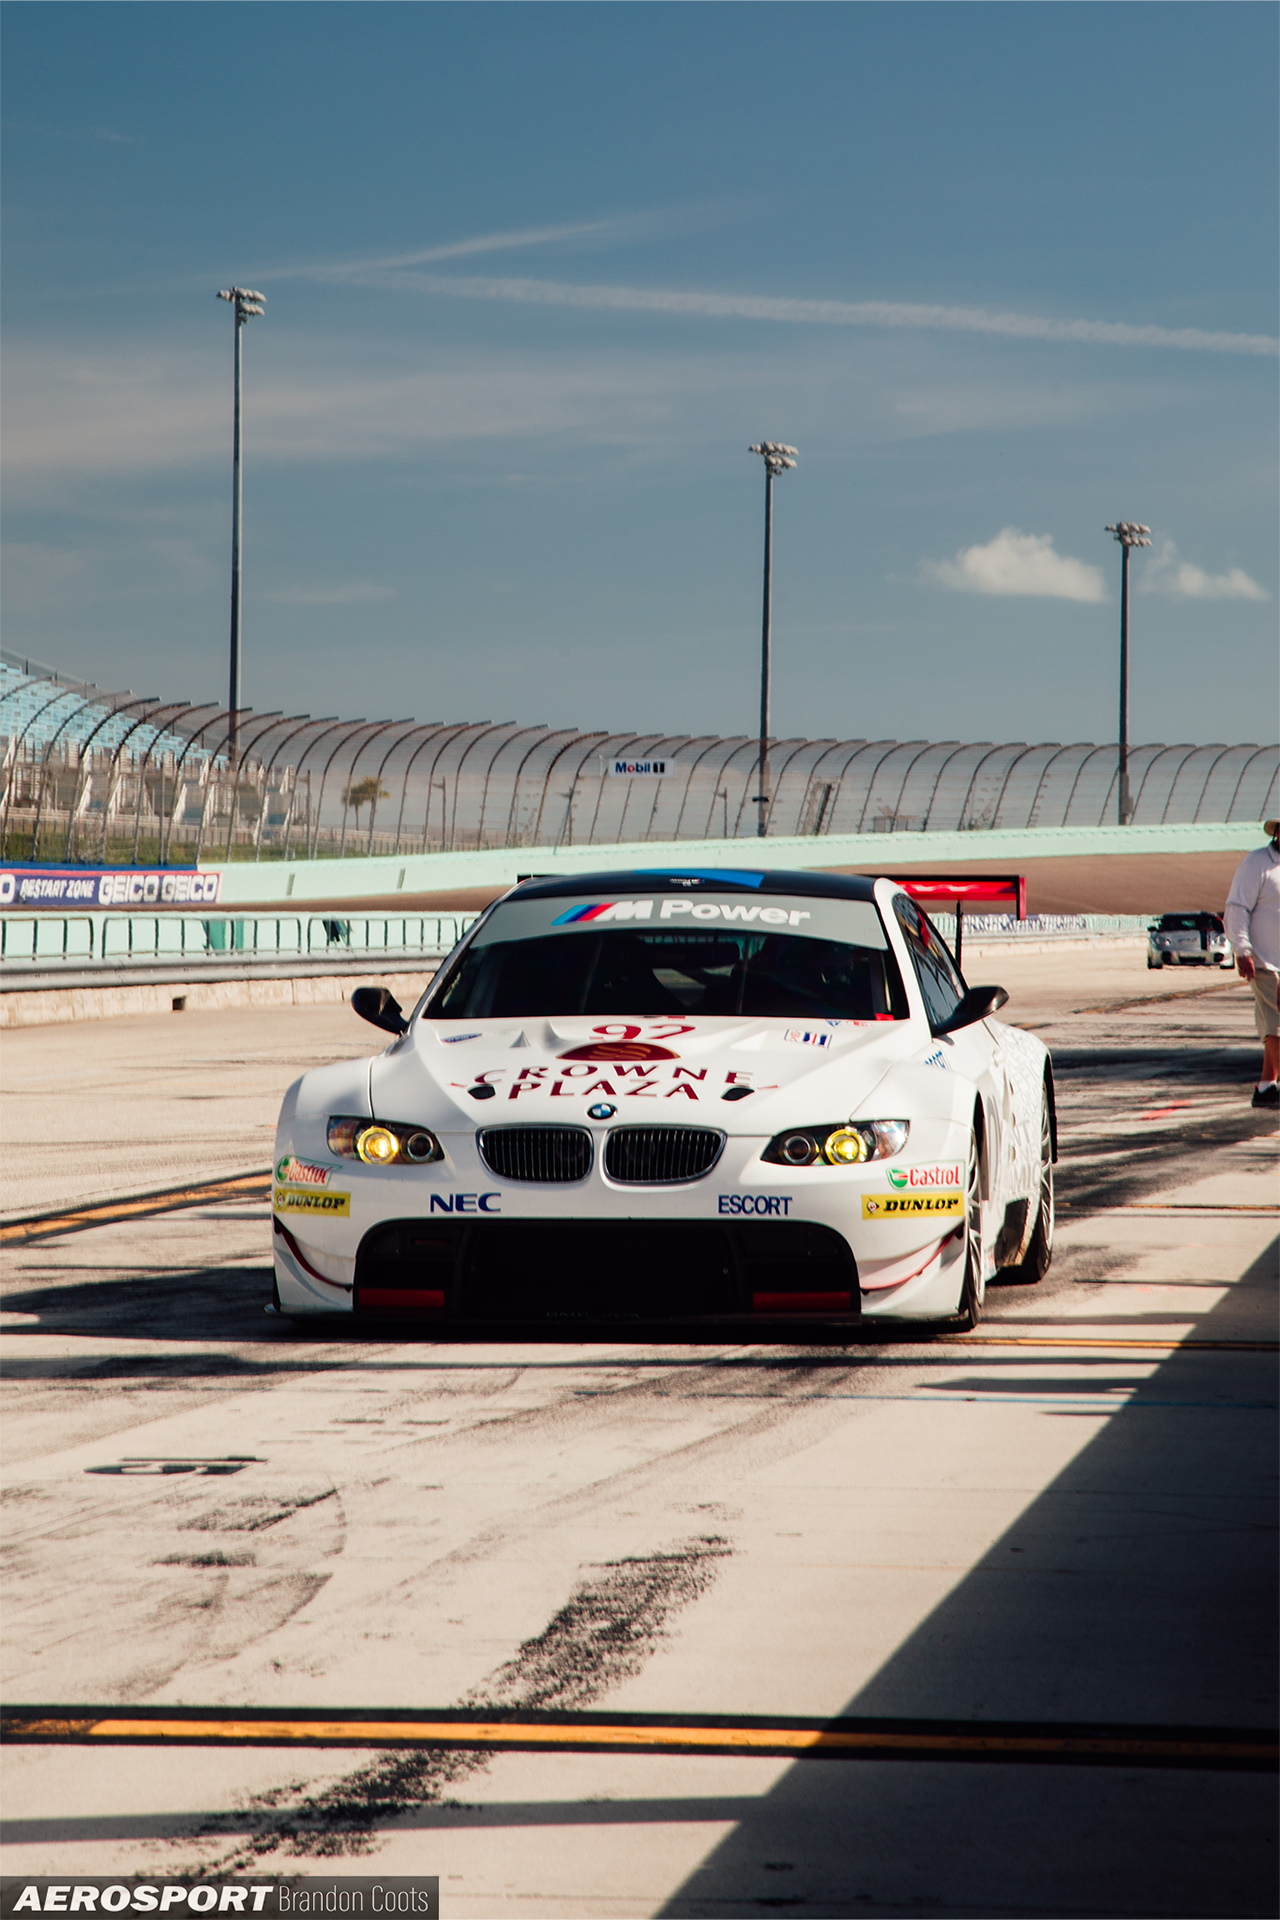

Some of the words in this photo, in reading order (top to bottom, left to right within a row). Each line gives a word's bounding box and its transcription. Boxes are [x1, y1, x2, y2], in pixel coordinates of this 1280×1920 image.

[615, 761, 651, 774] Mobil
[653, 761, 665, 773] 1
[19, 878, 67, 899] RESTART
[65, 879, 96, 899] ZONE
[98, 874, 160, 905] GEICO
[160, 875, 218, 902] GEICO
[660, 899, 811, 927] Power
[474, 1064, 754, 1085] CROWNE
[507, 1079, 701, 1101] PLAZA
[288, 1159, 334, 1185] Castrol
[909, 1165, 961, 1187] Castrol
[286, 1193, 346, 1209] DUNLOP
[430, 1192, 502, 1213] NEC
[718, 1194, 793, 1215] ESCORT
[883, 1197, 959, 1212] DUNLOP
